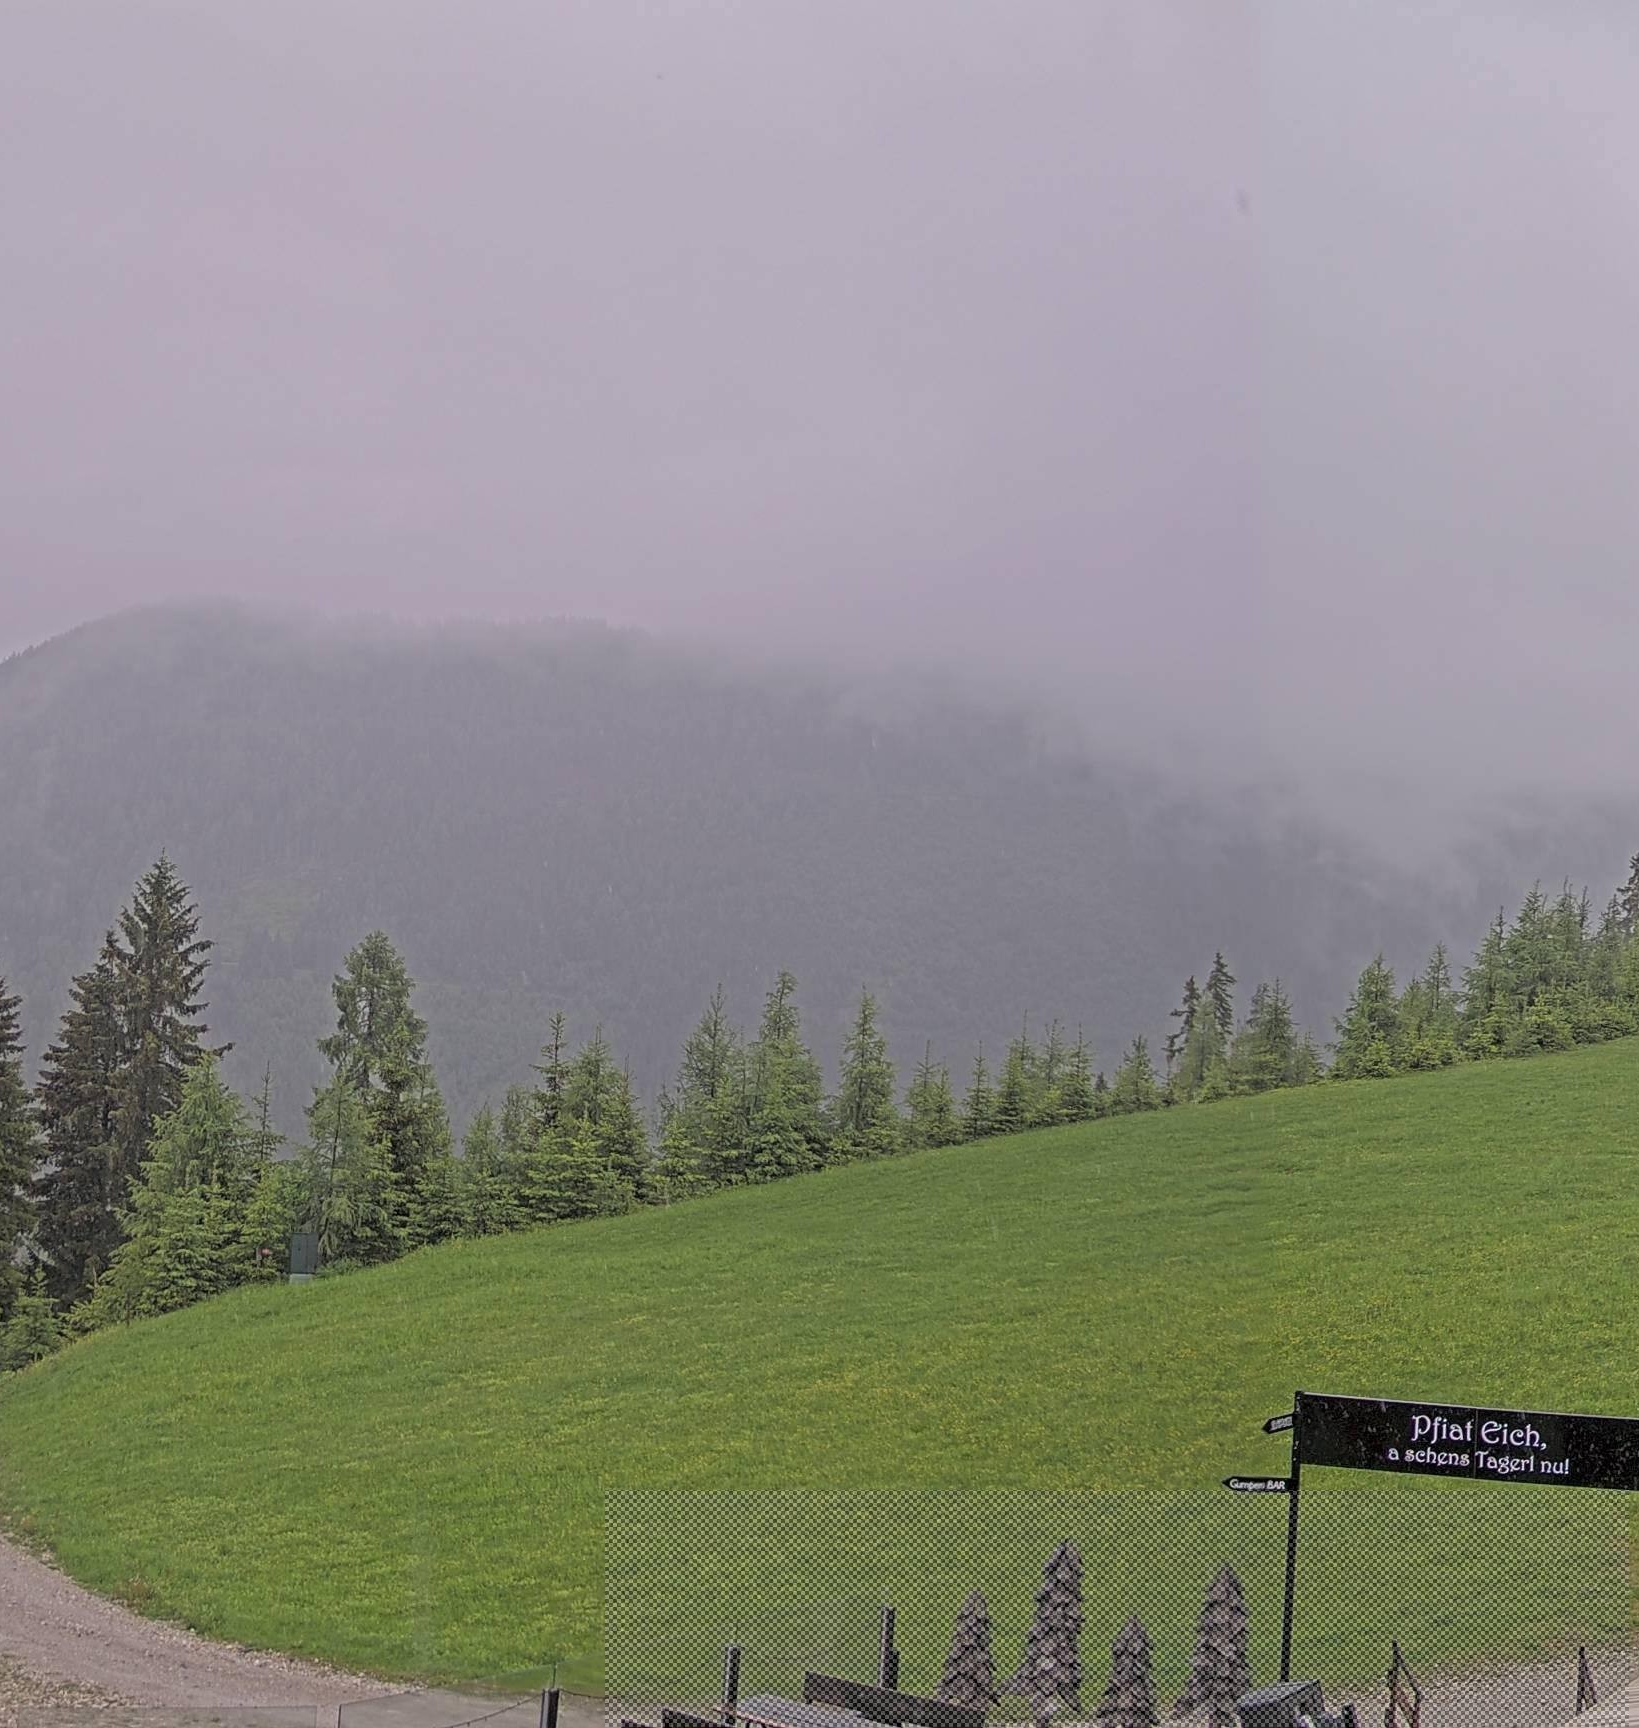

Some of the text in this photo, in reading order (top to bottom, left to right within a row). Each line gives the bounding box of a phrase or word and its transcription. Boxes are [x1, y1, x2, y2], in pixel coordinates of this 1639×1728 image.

[1411, 1415, 1547, 1450] Pfiat Eich,
[1388, 1447, 1570, 1475] a schens Tagerl nu!
[1266, 1479, 1286, 1490] BAR
